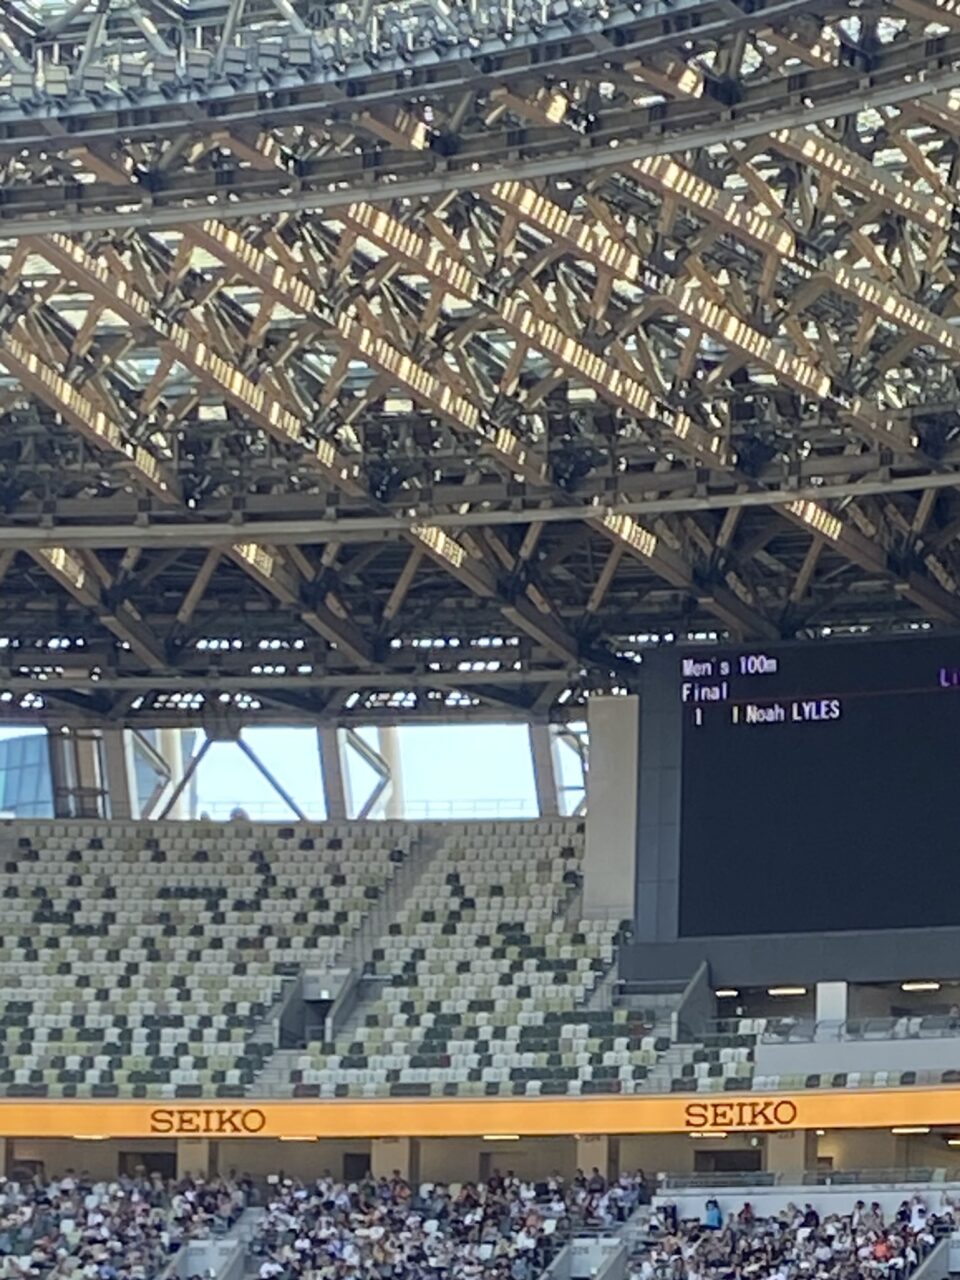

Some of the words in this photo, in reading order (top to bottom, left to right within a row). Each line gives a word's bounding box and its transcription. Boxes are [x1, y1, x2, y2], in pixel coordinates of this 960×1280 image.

[740, 655, 777, 675] 100m
[682, 682, 728, 702] Final
[745, 703, 785, 724] Noah
[792, 700, 840, 721] LYLES
[150, 1109, 266, 1133] SEIKO
[685, 1100, 797, 1127] SEIKO
